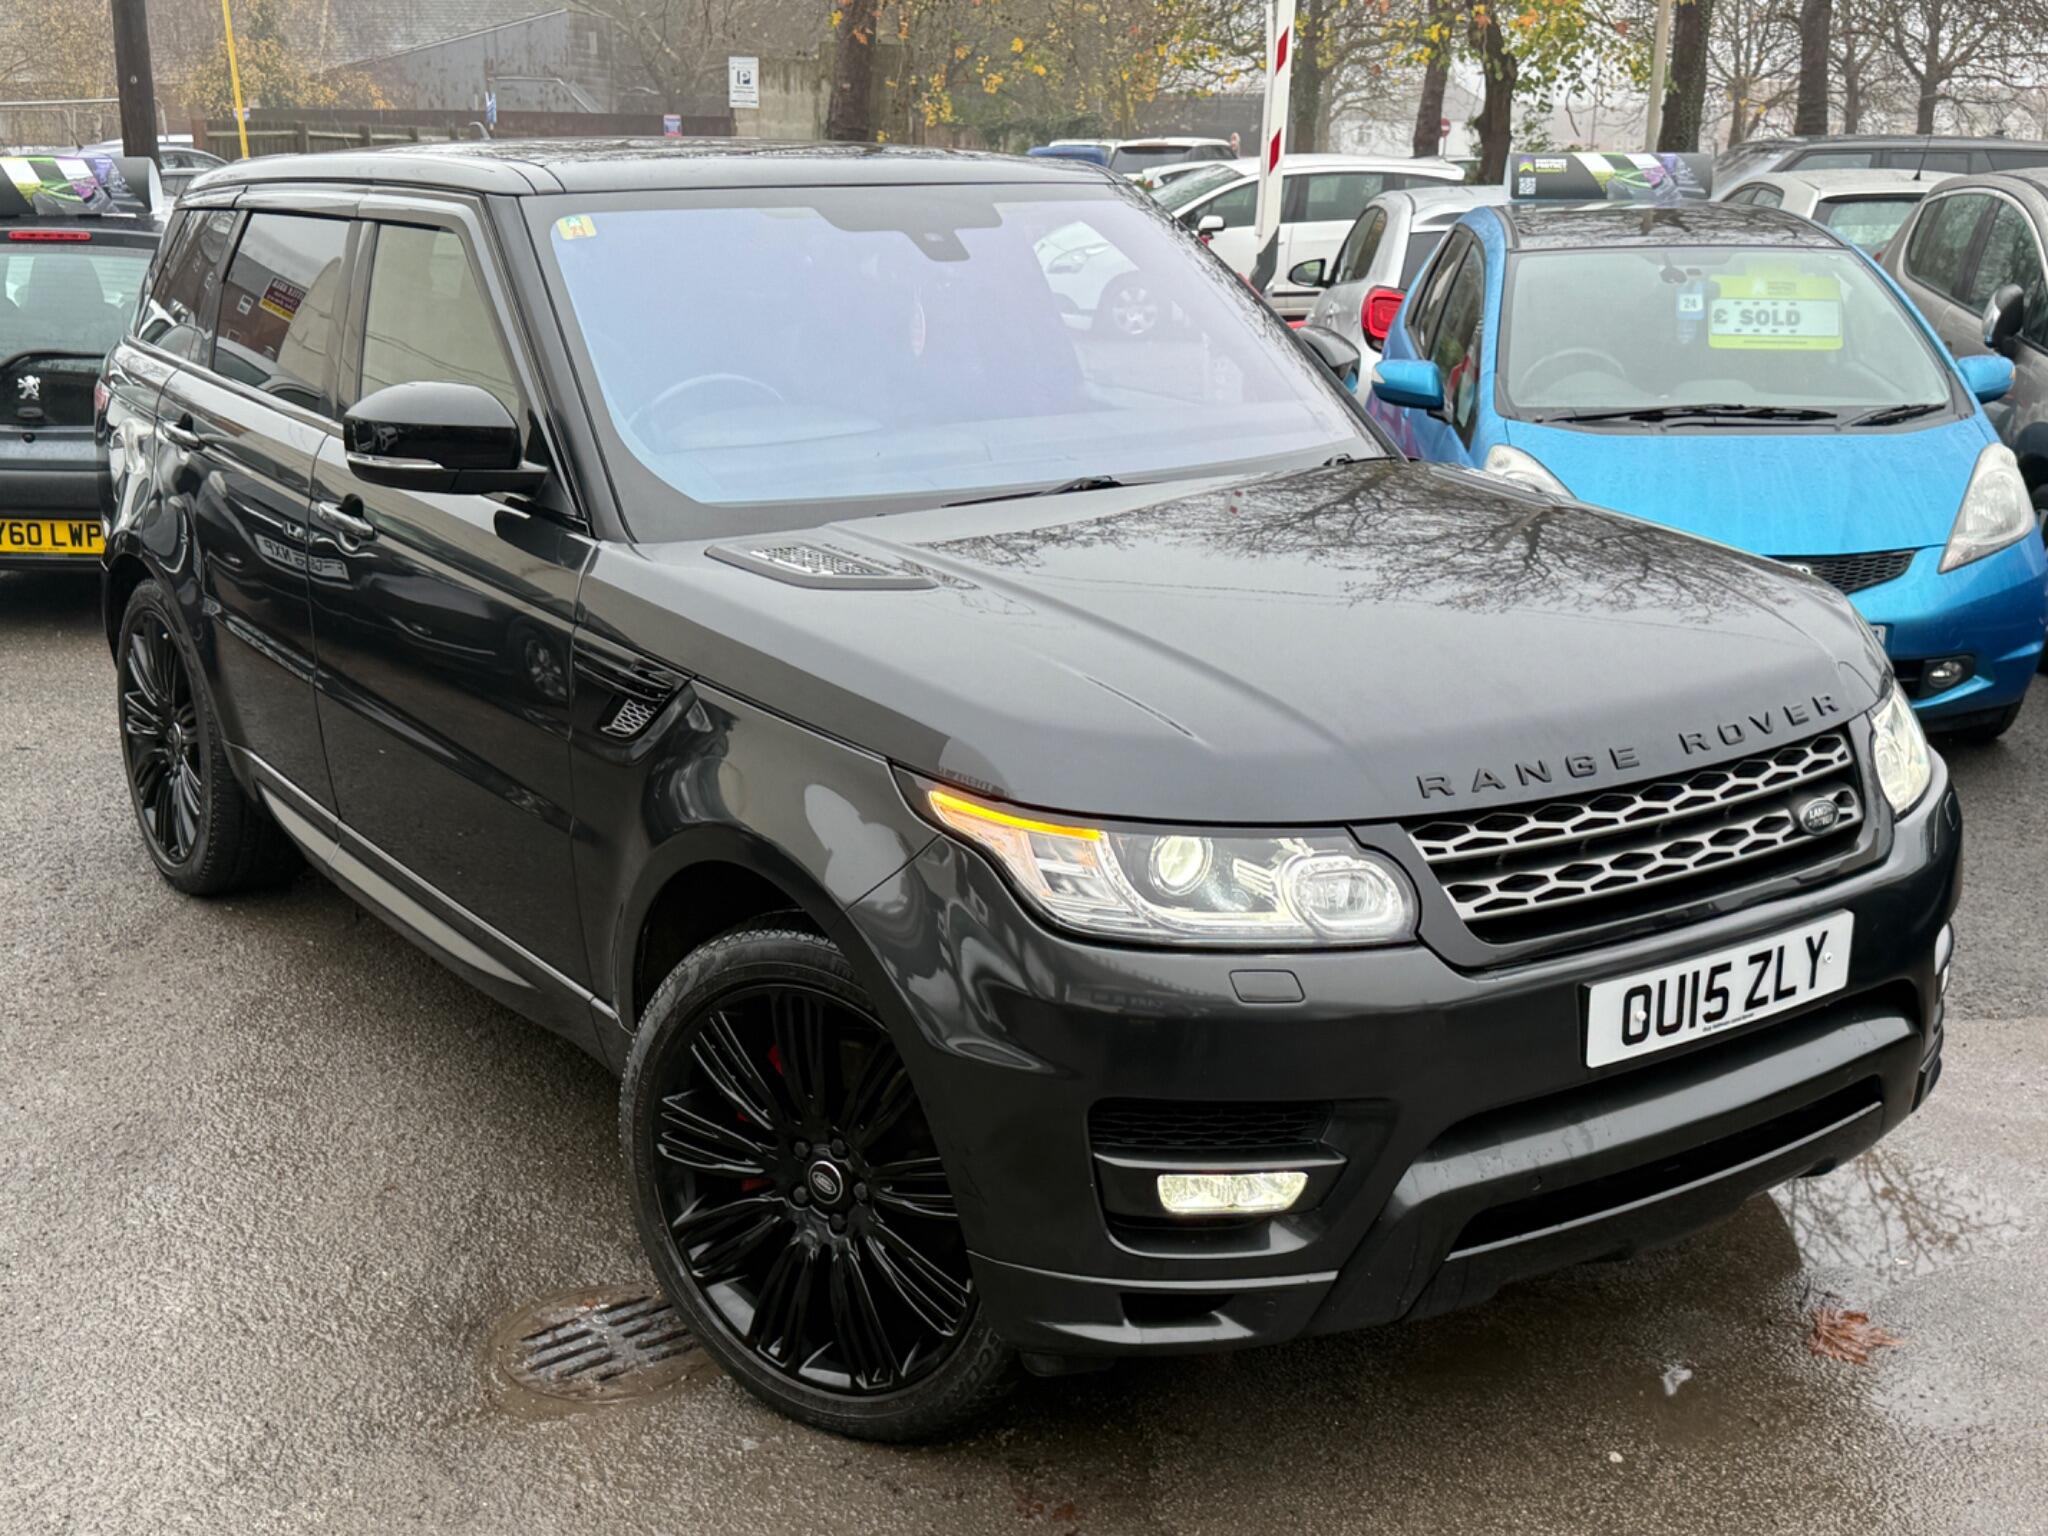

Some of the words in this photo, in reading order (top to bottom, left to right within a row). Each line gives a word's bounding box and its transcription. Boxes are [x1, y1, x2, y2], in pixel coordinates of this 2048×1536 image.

[1713, 308, 1728, 324] £
[1739, 308, 1801, 326] SOLD
[50, 523, 102, 547] LWP
[1417, 746, 1640, 799] RANGE
[1679, 695, 1840, 755] ROVER
[1621, 961, 1732, 1046] OU15
[1744, 930, 1829, 1012] ZLY
